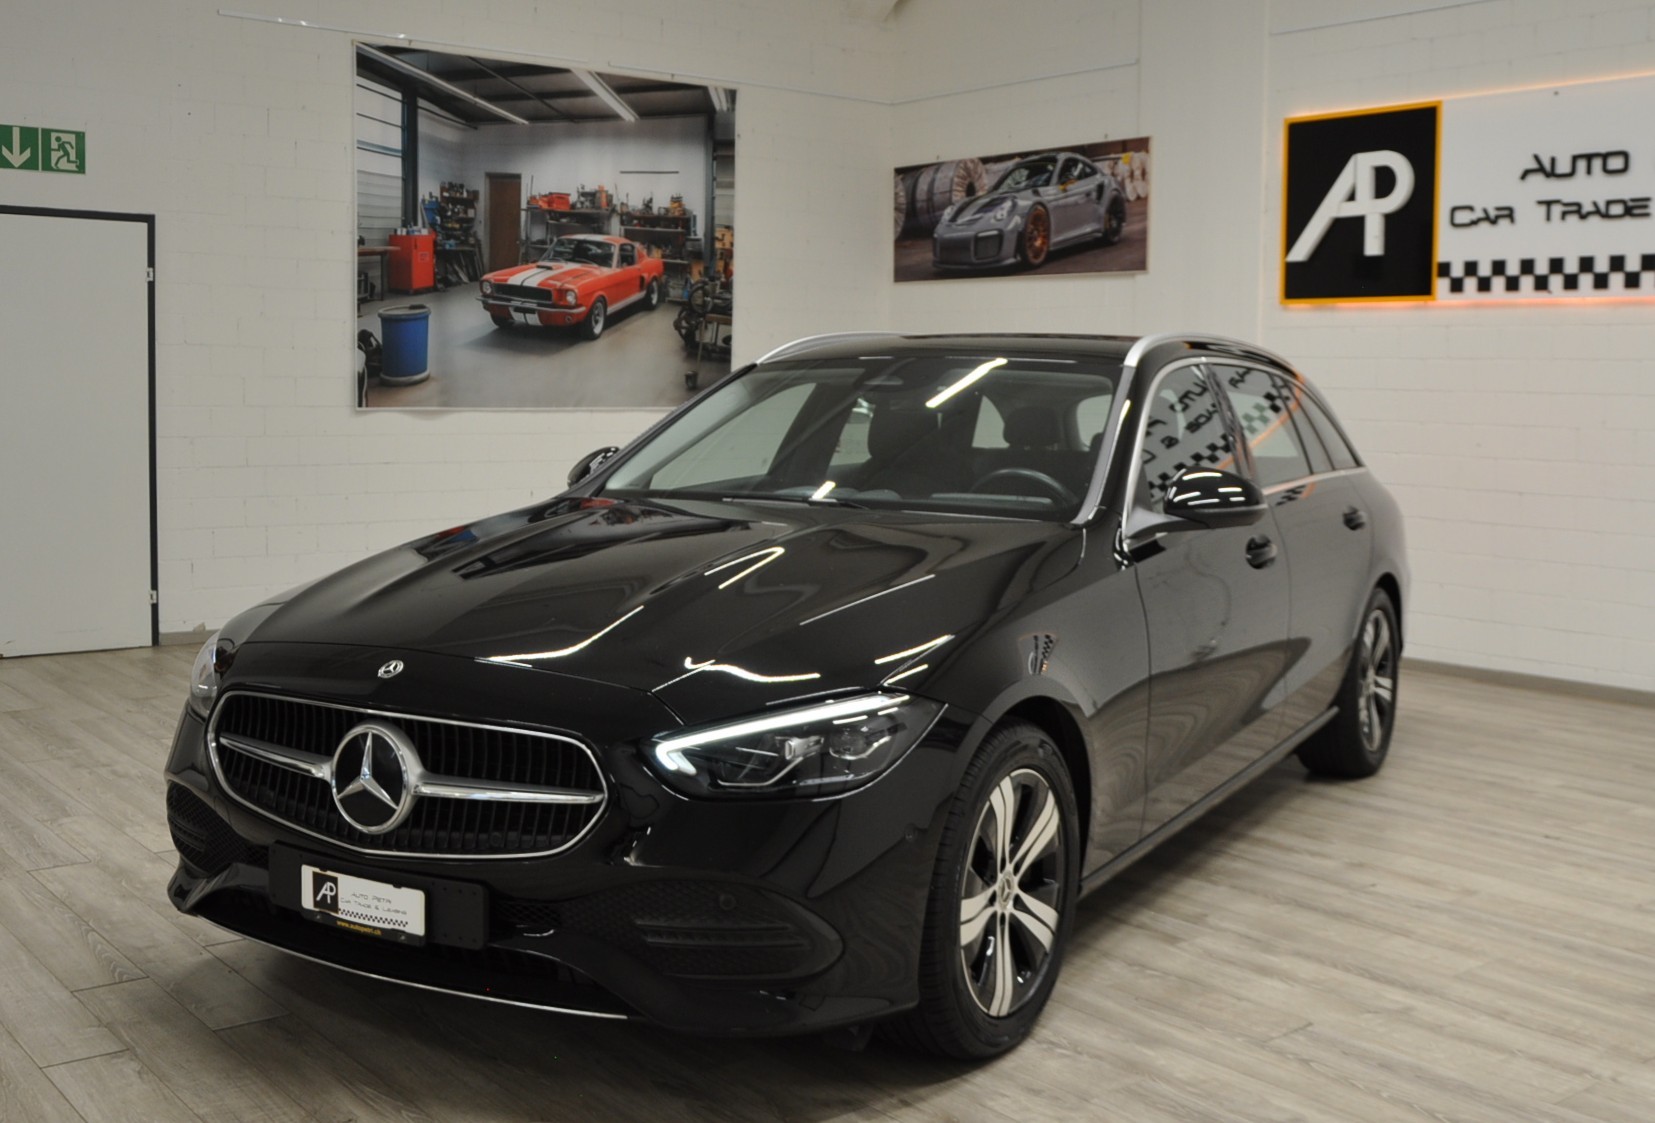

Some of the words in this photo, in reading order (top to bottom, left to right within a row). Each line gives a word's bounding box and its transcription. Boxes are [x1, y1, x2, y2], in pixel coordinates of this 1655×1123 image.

[1520, 150, 1630, 181] AUTO
[1450, 204, 1516, 229] CAR
[1536, 197, 1652, 223] TRADE
[352, 892, 369, 900] AUTO
